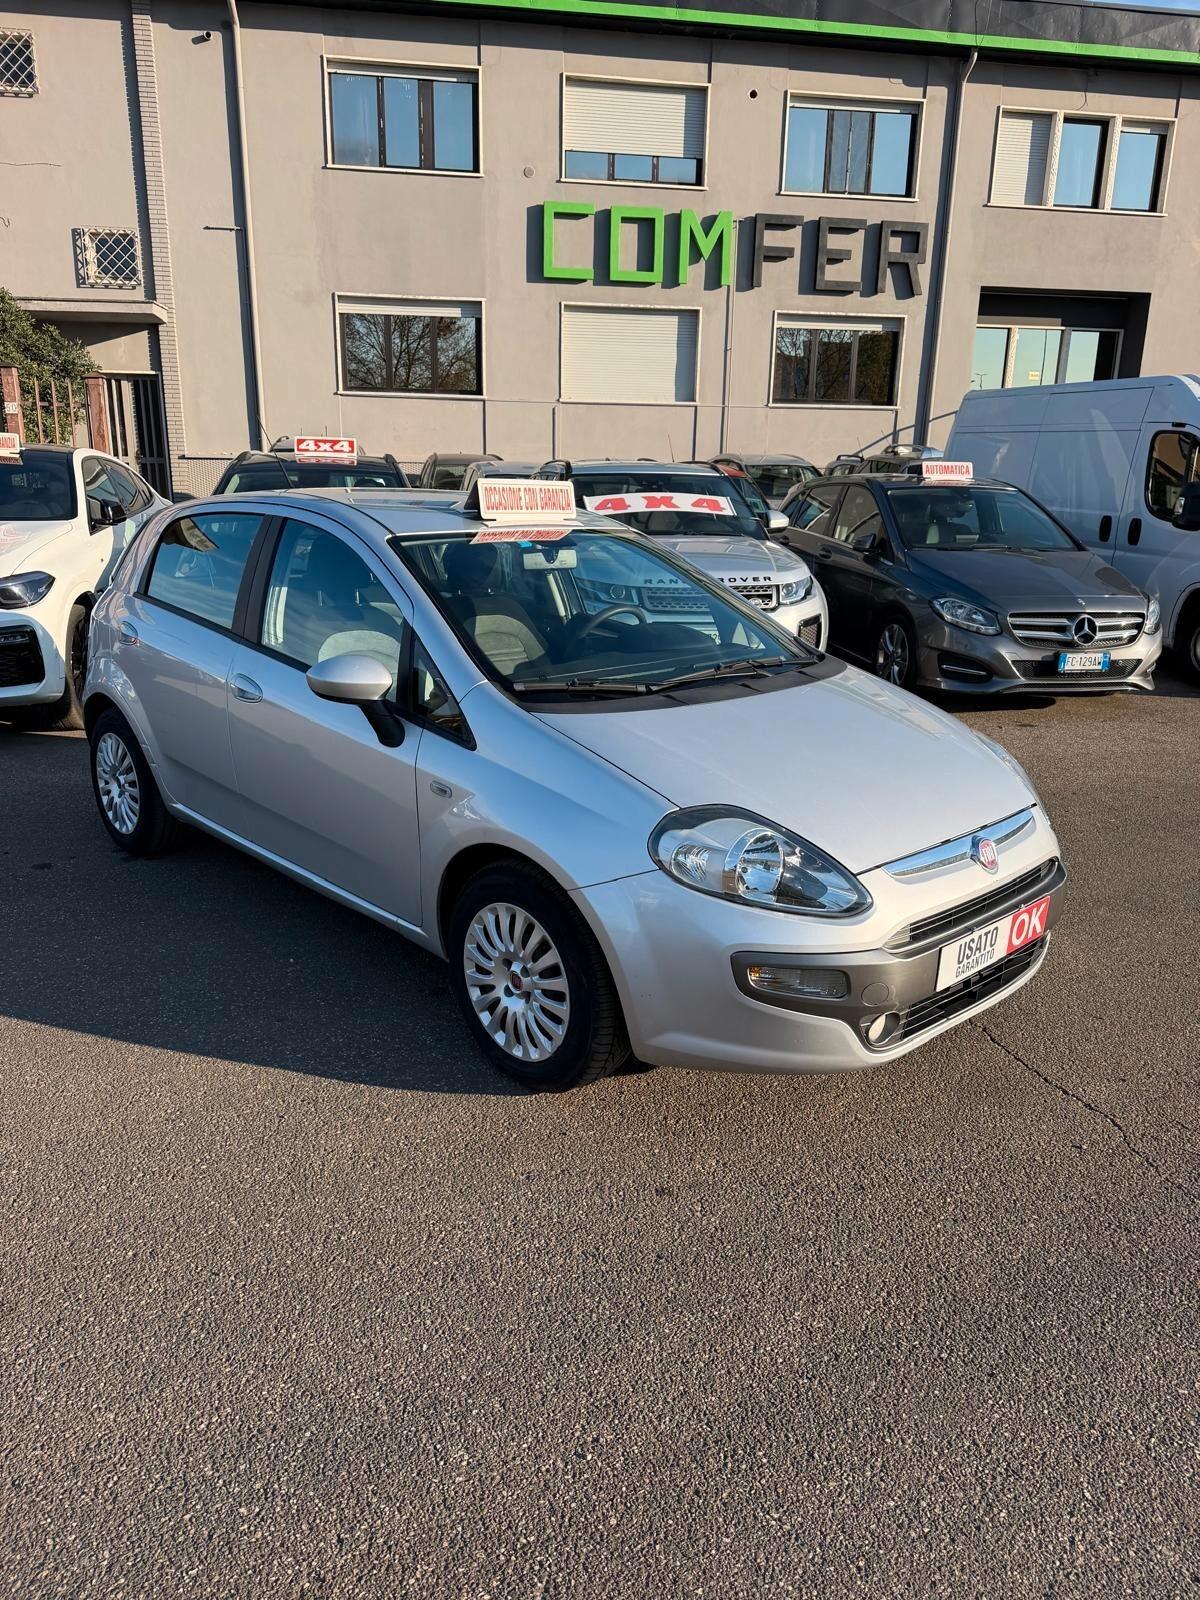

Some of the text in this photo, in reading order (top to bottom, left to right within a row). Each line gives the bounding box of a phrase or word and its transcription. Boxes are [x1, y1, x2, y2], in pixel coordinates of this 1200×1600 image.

[543, 200, 930, 295] COMFER
[925, 464, 970, 475] AUTOMATICA
[484, 486, 572, 511] OCCASIONE CON GARANZIA
[1011, 902, 1047, 947] OK
[957, 926, 999, 965] USATO
[955, 949, 995, 978] GARANTITO
